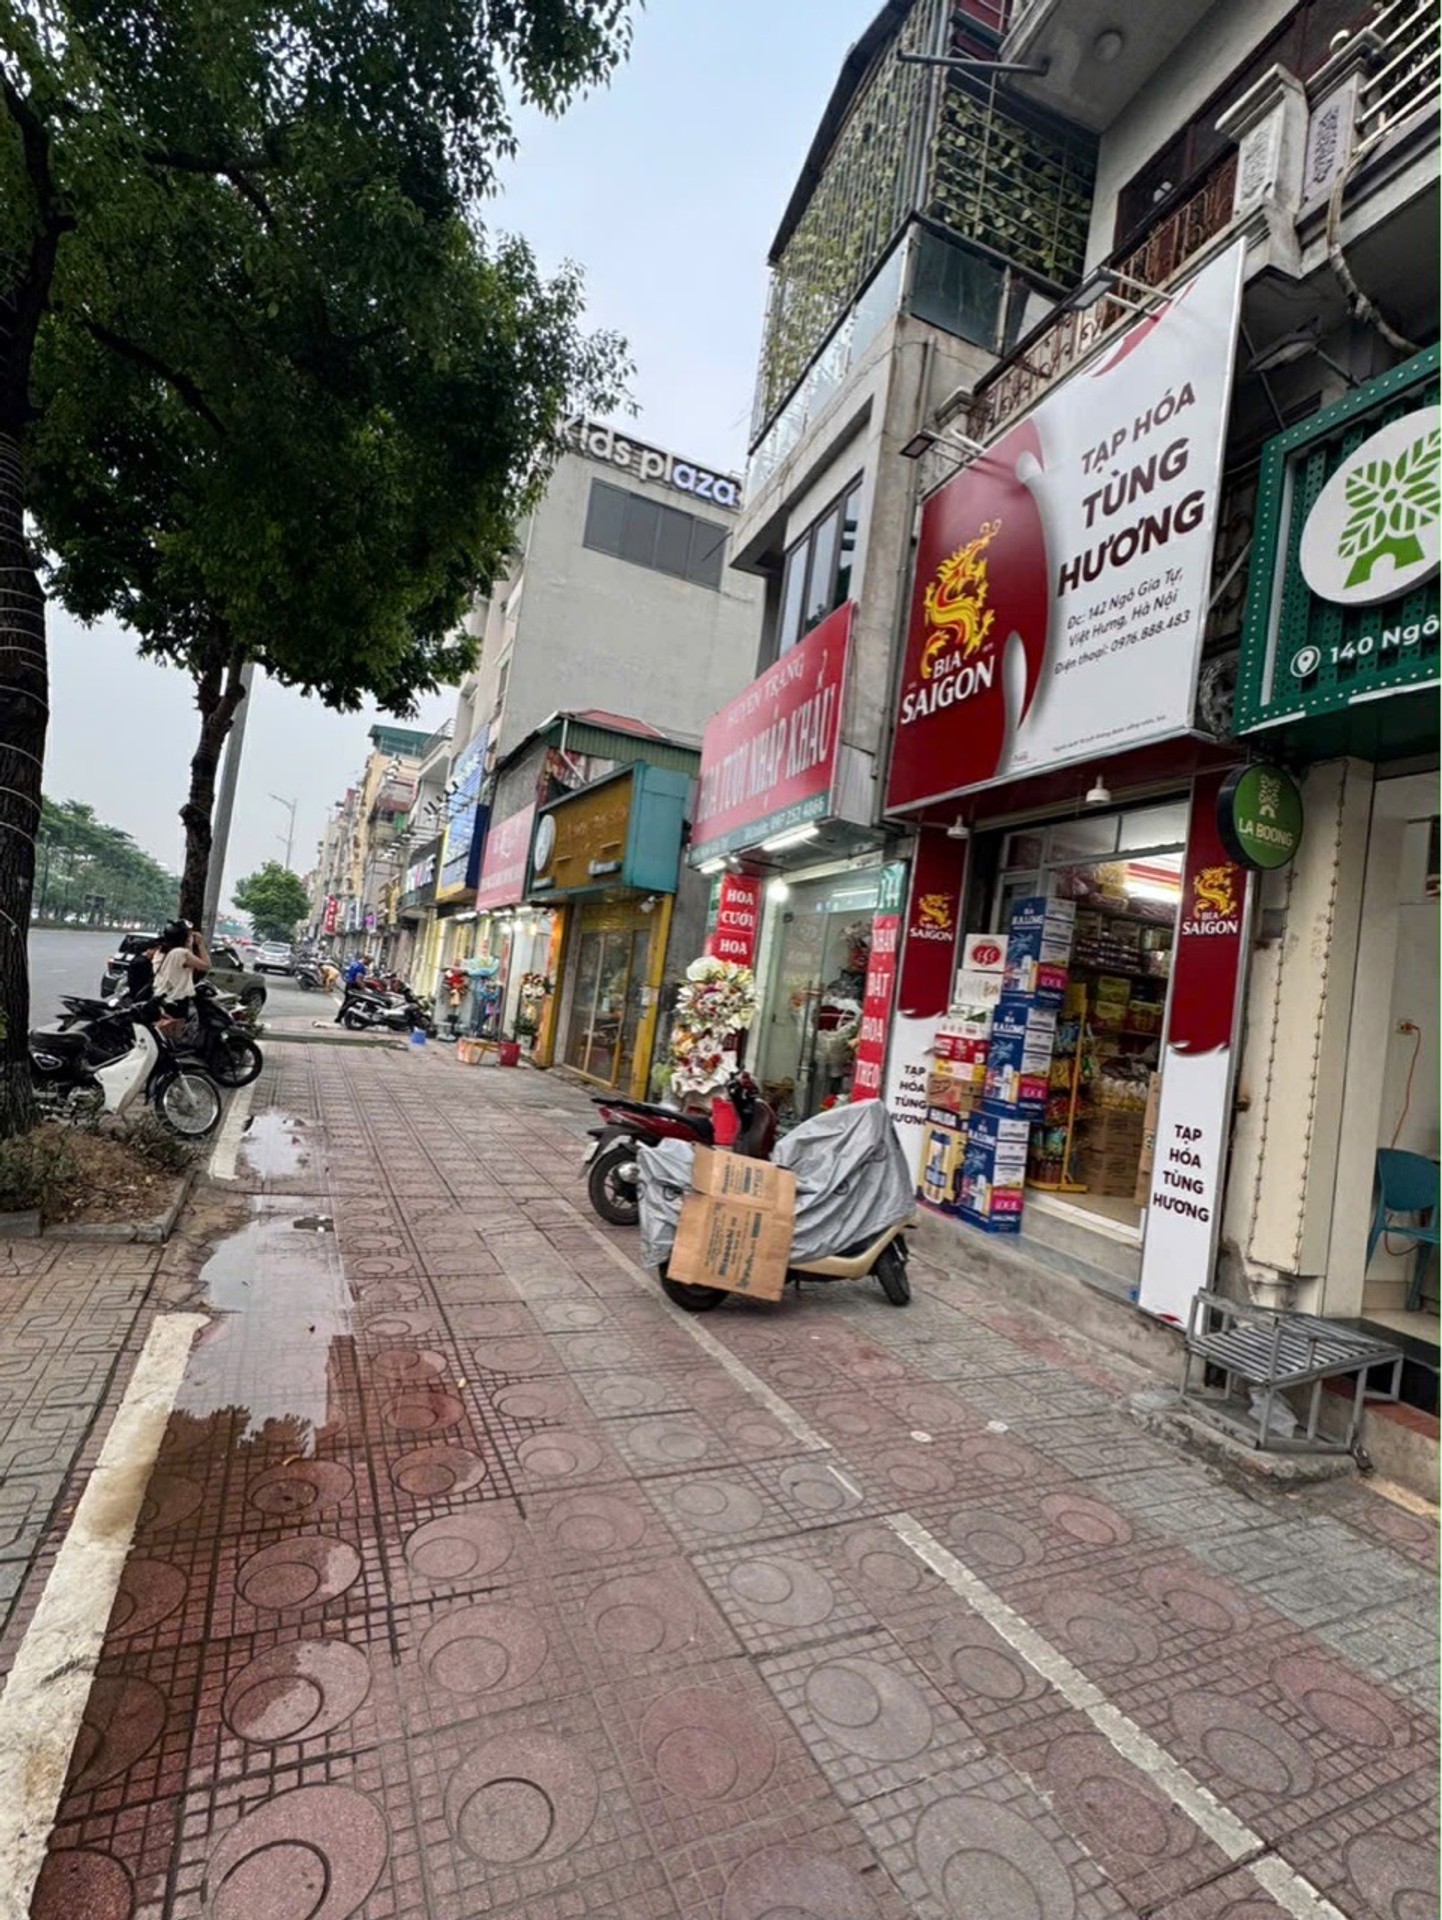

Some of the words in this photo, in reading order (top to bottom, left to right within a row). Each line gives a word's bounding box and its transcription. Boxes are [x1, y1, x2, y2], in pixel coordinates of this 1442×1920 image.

[1081, 428, 1127, 475] TẠP
[1133, 382, 1196, 442] HÓA
[640, 449, 738, 506] plaza
[1082, 437, 1190, 529] TÙNG
[1057, 489, 1206, 597] HƯƠNG
[1088, 601, 1107, 620] 142
[1108, 587, 1135, 610] Ngô
[1137, 577, 1161, 597] Gia
[1131, 603, 1150, 621] Hà
[1153, 588, 1178, 611] Nội
[1330, 636, 1374, 664] 140
[1382, 614, 1439, 646] Ngô
[932, 650, 962, 679] BIA
[900, 655, 996, 725] SAIGON
[1239, 817, 1254, 836] LA
[1255, 823, 1294, 847] BOONG
[726, 887, 754, 906] HOA
[909, 927, 953, 941] SAIGON
[1181, 920, 1239, 936] SAIGON
[719, 937, 749, 956] HOA
[904, 1064, 926, 1078] TẠP
[899, 1080, 925, 1093] HÓA
[894, 1094, 927, 1110] TÙNG
[1174, 1124, 1203, 1145] TẠP
[1168, 1146, 1202, 1169] HÓA
[1162, 1169, 1204, 1195] TÙNG
[1152, 1192, 1210, 1223] HƯƠNG
